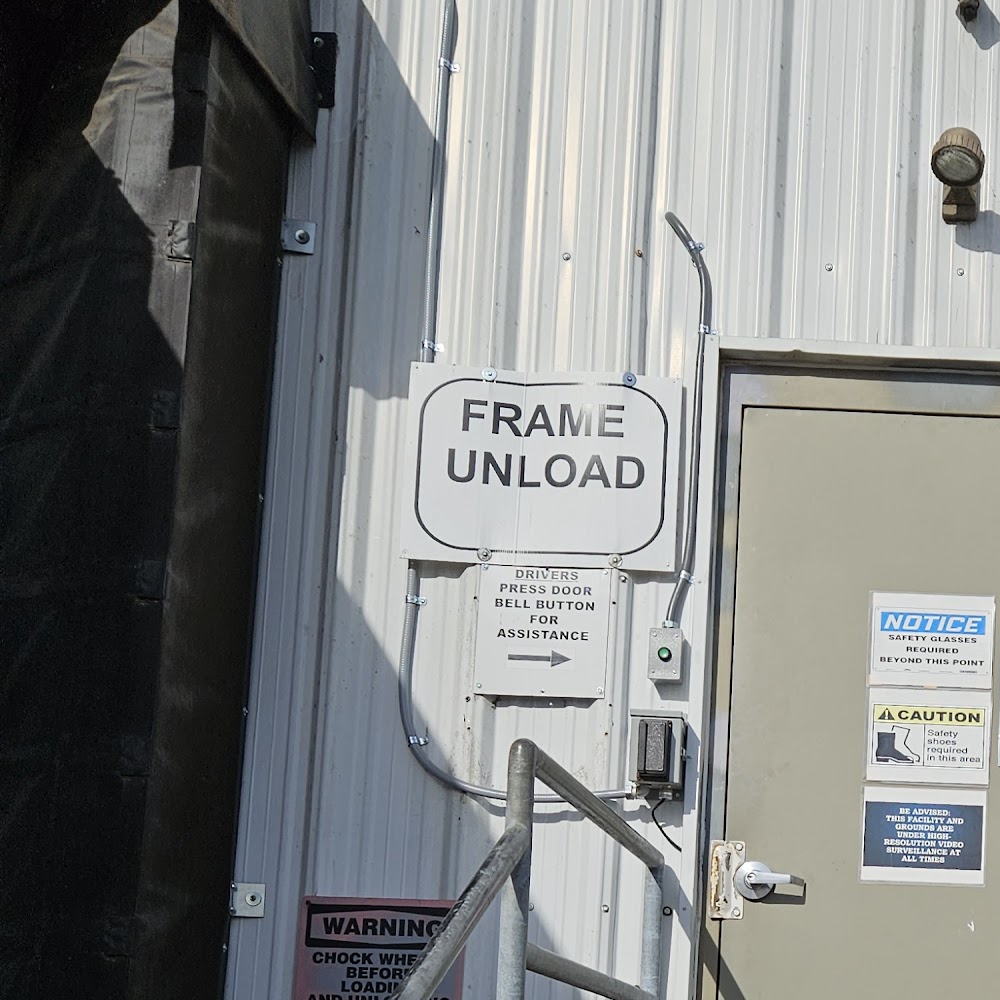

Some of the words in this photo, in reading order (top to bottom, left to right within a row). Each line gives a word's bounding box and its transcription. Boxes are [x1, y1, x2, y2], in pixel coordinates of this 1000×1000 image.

[461, 398, 625, 438] FRAME
[447, 448, 645, 490] UNLOAD
[515, 569, 578, 582] DRIVERS
[500, 583, 548, 595] PRESS
[551, 585, 592, 597] DOOR
[495, 598, 531, 610] BELL
[536, 600, 595, 612] BUTTON
[530, 614, 558, 626] FOR
[884, 614, 982, 633] NOTICE
[497, 628, 589, 642] ASSISTANCE
[888, 634, 927, 642] SAFETY
[930, 636, 977, 644] GLASSES
[906, 646, 959, 654] REQUIRED
[880, 656, 922, 664] BEYOND
[953, 659, 984, 667] POINT
[897, 710, 981, 723] CAUTION
[927, 729, 958, 739] Safety
[927, 738, 957, 746] shoes
[926, 746, 968, 756] required
[926, 754, 936, 762] in
[937, 754, 957, 763] this
[959, 756, 981, 764] area
[899, 807, 911, 815] BE
[912, 808, 951, 816] ADVISED:
[907, 815, 946, 824] FACILITY
[946, 817, 964, 825] AND
[895, 823, 935, 832] GROUNDS
[897, 831, 926, 839] UNDER
[927, 832, 952, 840] HIGH-
[883, 838, 936, 848] RESOLUTION
[938, 840, 964, 849] VIDEO
[886, 846, 948, 855] SURVEILLANCE
[901, 855, 917, 863] ALL
[918, 855, 945, 863] TIMES
[312, 952, 373, 965] CHOCK
[379, 953, 420, 966] WHE
[341, 981, 399, 994] LOADI
